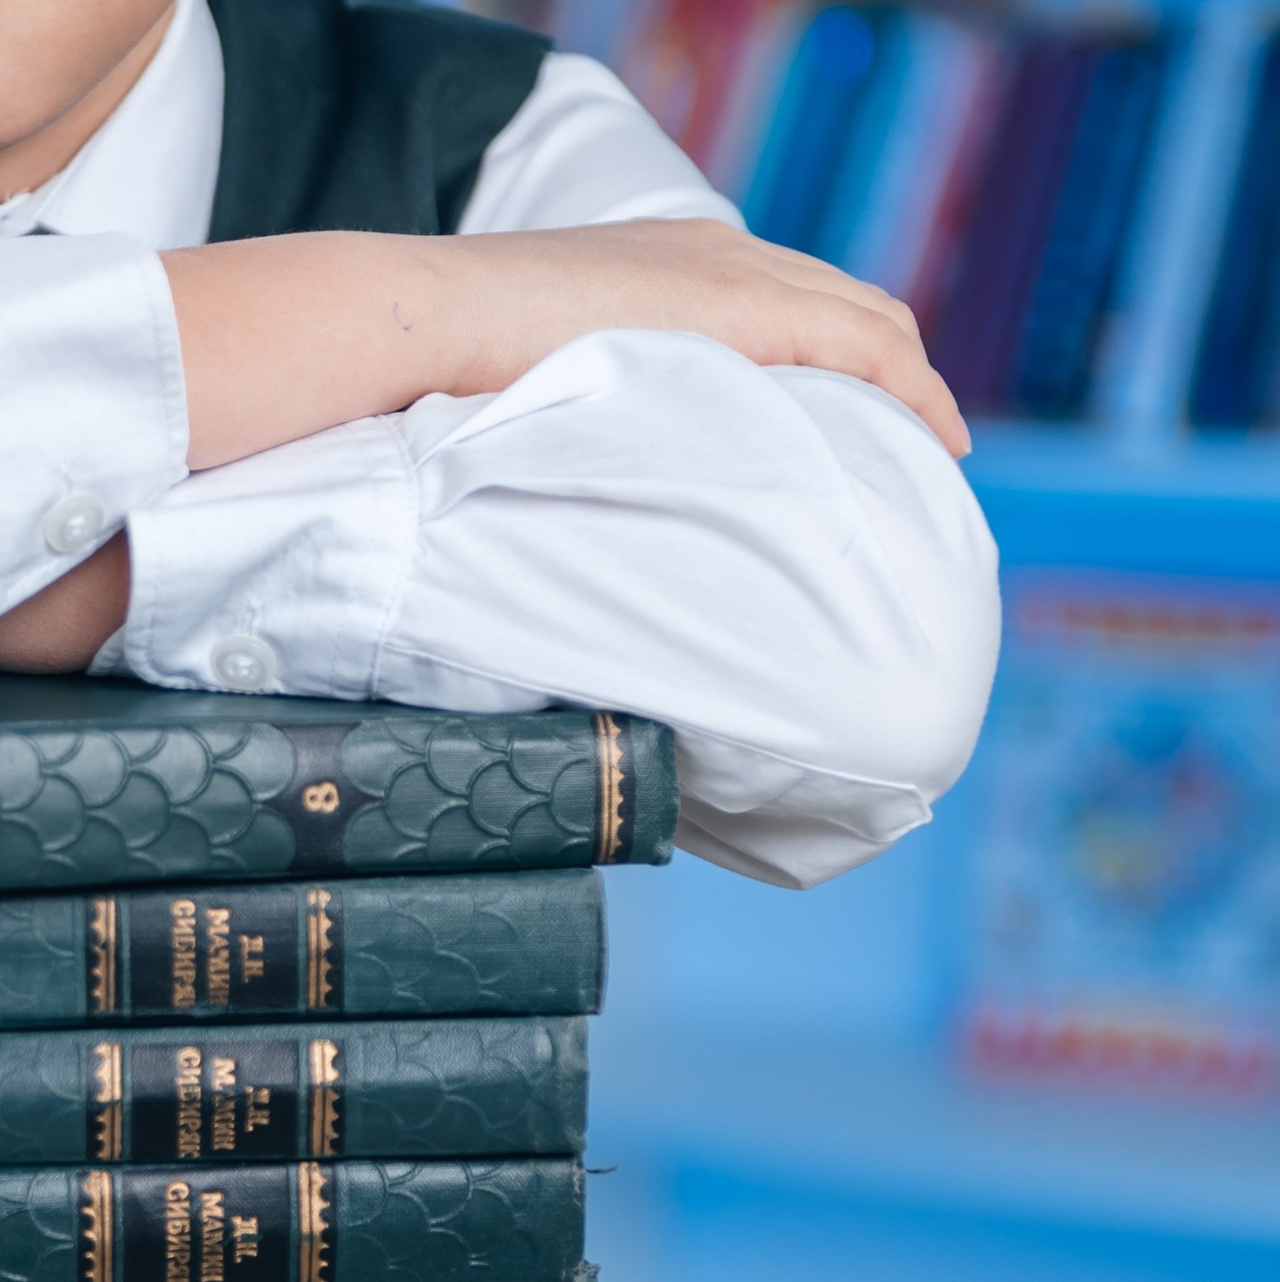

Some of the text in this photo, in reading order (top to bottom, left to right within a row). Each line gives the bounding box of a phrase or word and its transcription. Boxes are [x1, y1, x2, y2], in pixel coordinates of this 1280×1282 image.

[303, 782, 339, 813] 8
[206, 908, 231, 1005] МАМИН
[200, 1191, 225, 1282] МАМИН
